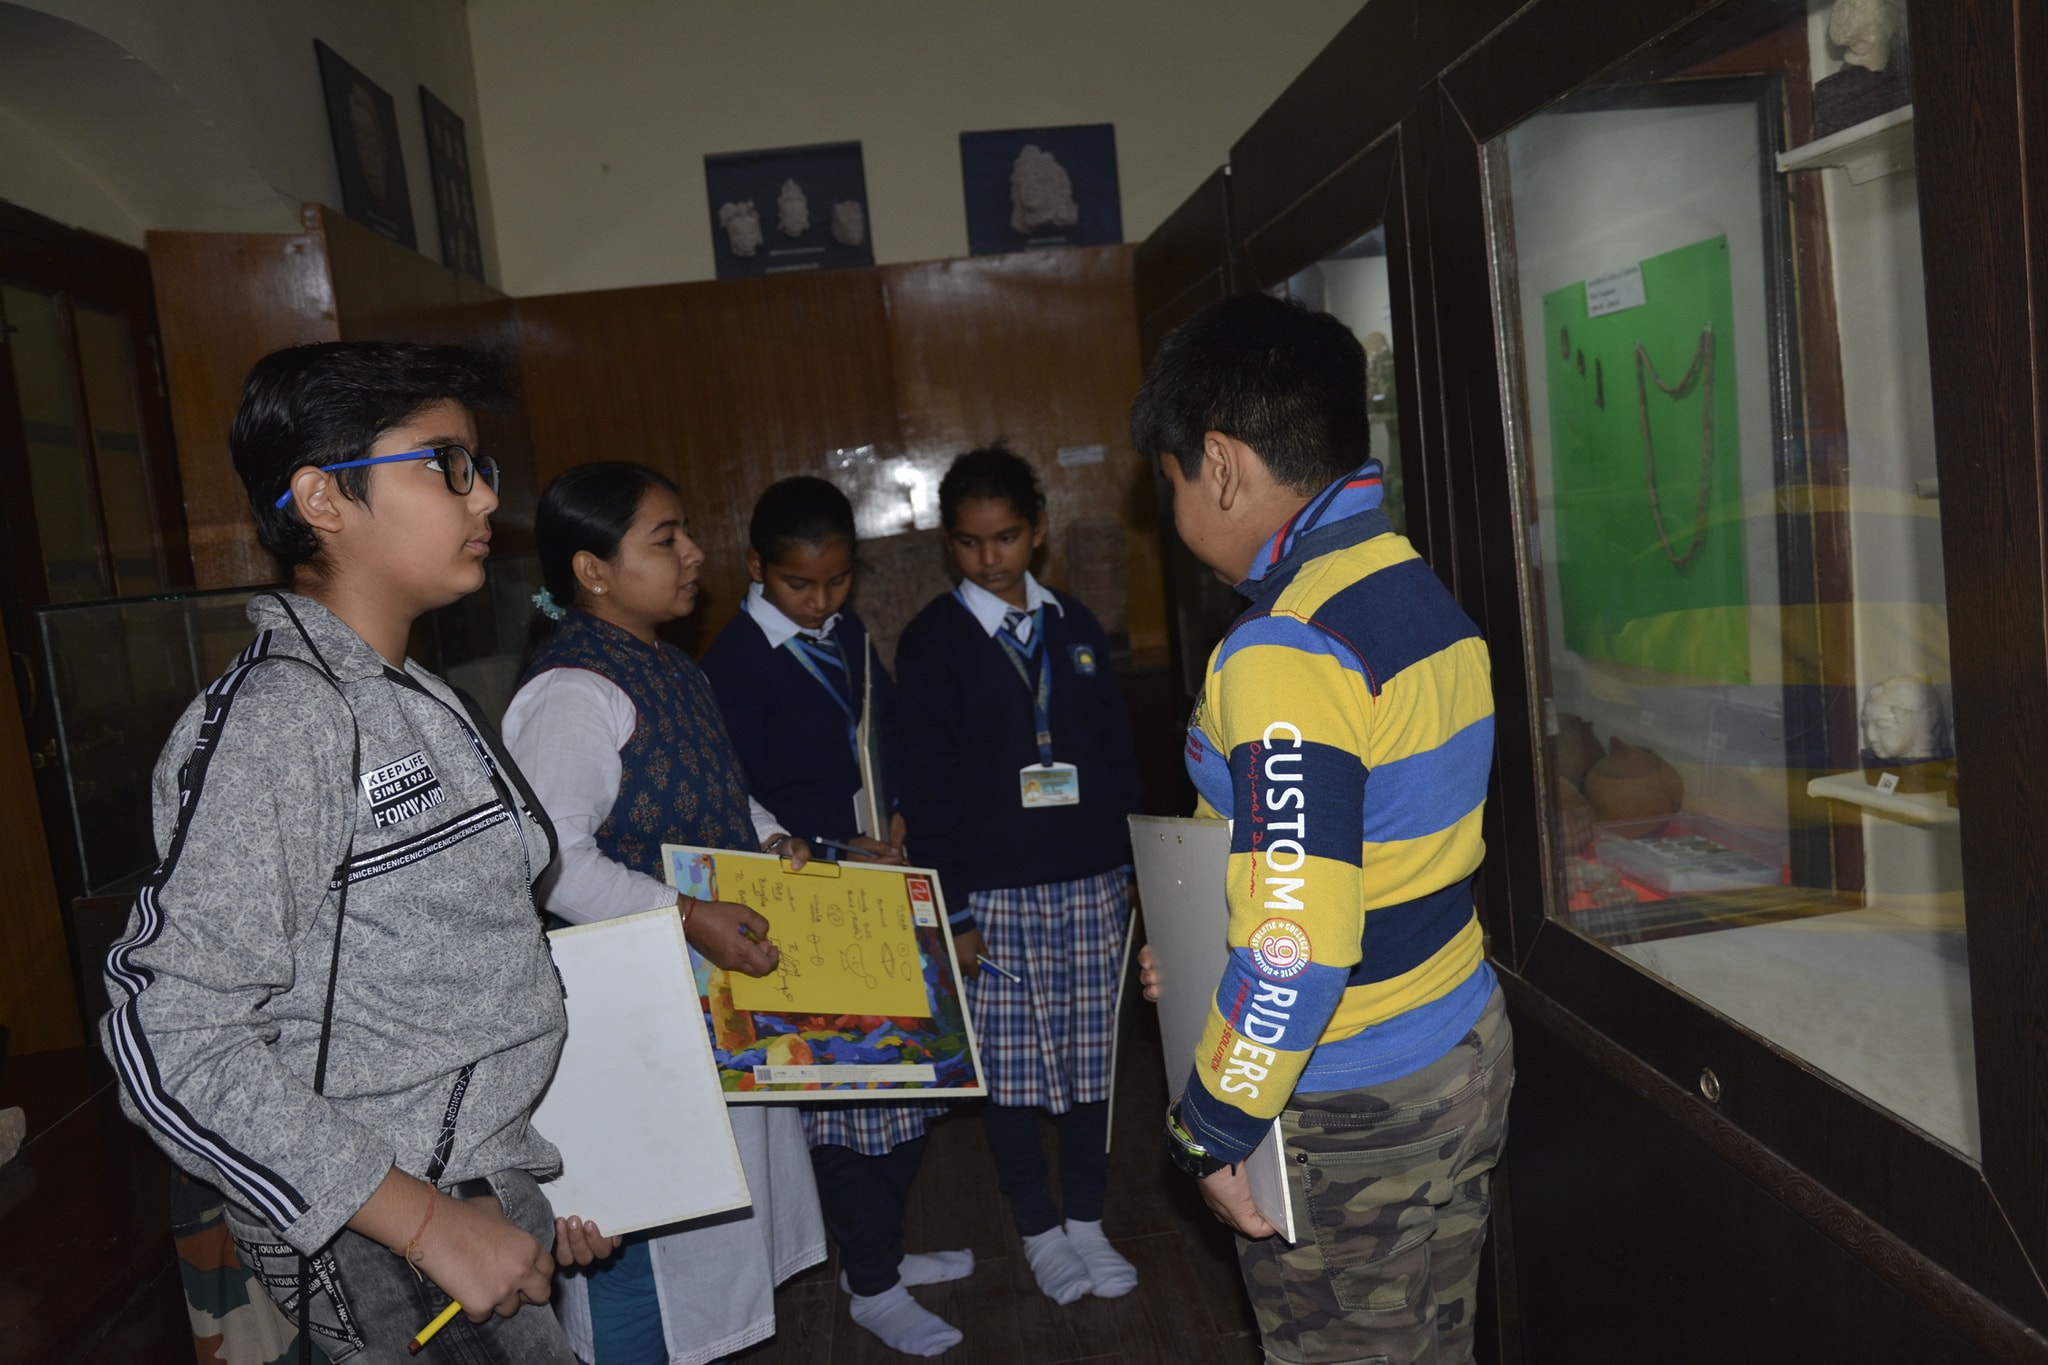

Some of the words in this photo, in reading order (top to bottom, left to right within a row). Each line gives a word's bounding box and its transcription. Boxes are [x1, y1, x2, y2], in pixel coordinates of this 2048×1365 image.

[367, 754, 426, 788] KEEPLIFE
[373, 782, 403, 801] SINE
[1247, 741, 1265, 824] Original
[374, 786, 446, 829] FORWARD
[1262, 721, 1306, 911] CUSTOM
[1261, 936, 1299, 967] 9
[1209, 1028, 1233, 1074] SOLUTION
[1219, 980, 1299, 1100] RIDERS
[446, 1080, 467, 1121] FASHION
[273, 1244, 293, 1255] GAIN
[273, 1277, 295, 1287] YOUR
